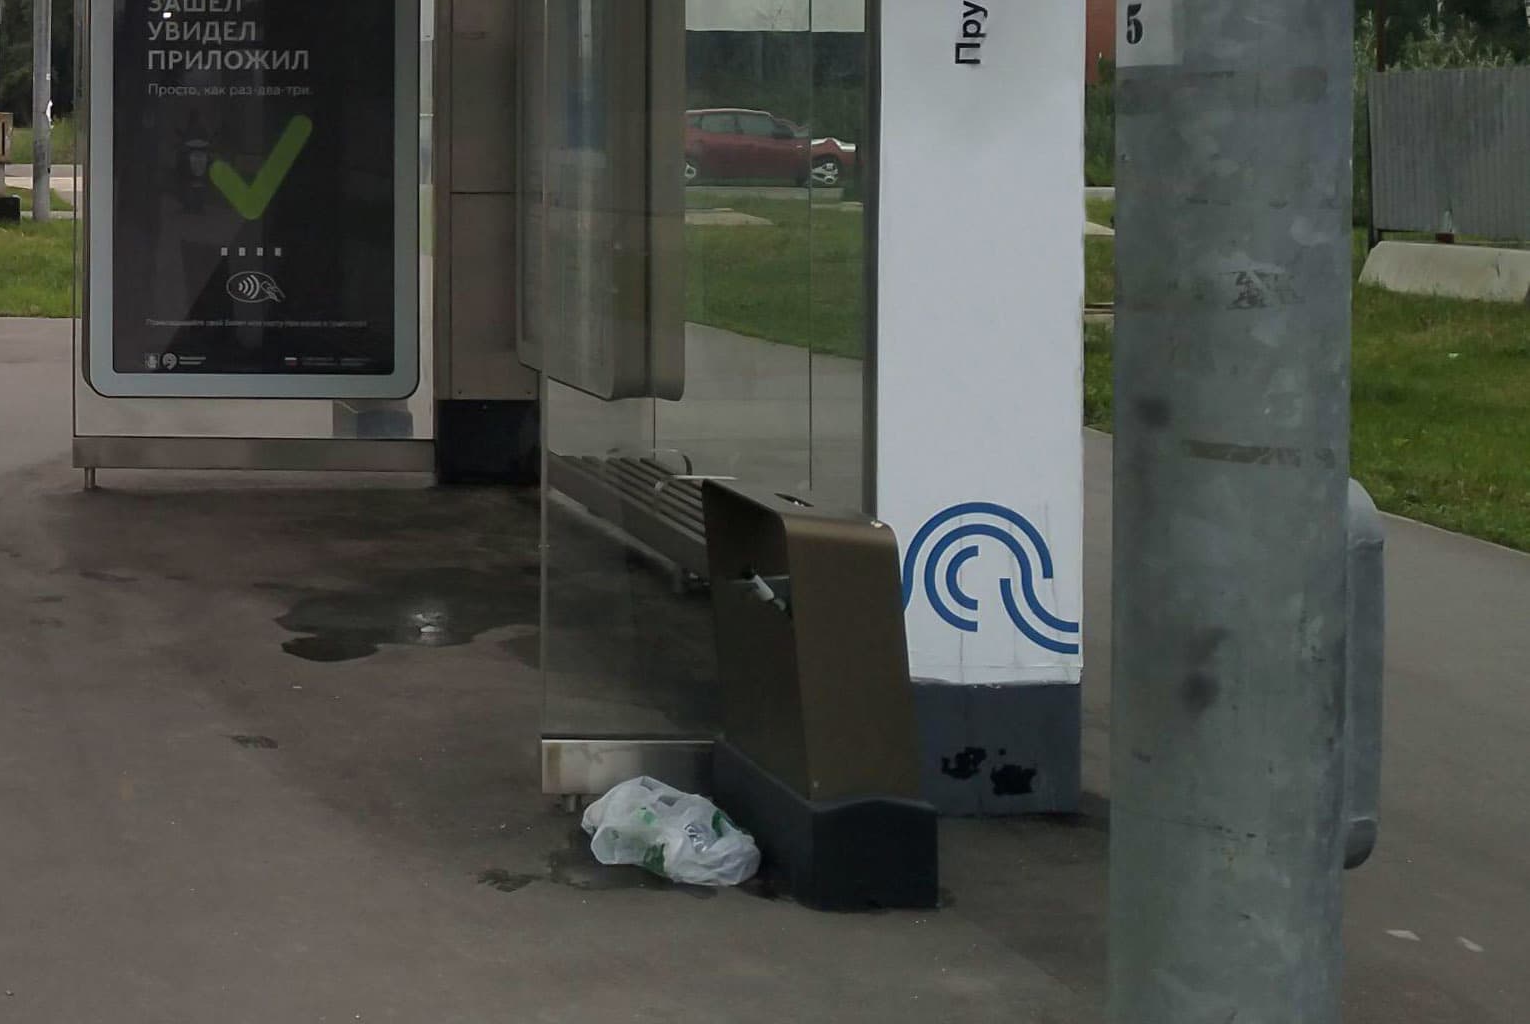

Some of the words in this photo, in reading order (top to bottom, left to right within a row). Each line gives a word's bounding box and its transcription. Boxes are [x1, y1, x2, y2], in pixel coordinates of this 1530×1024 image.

[148, 21, 256, 44] УВИДЕЛ
[1126, 3, 1143, 44] 5
[148, 50, 309, 70] ПРИЛОЖИЛ
[148, 83, 200, 97] Просто,
[204, 86, 226, 96] как
